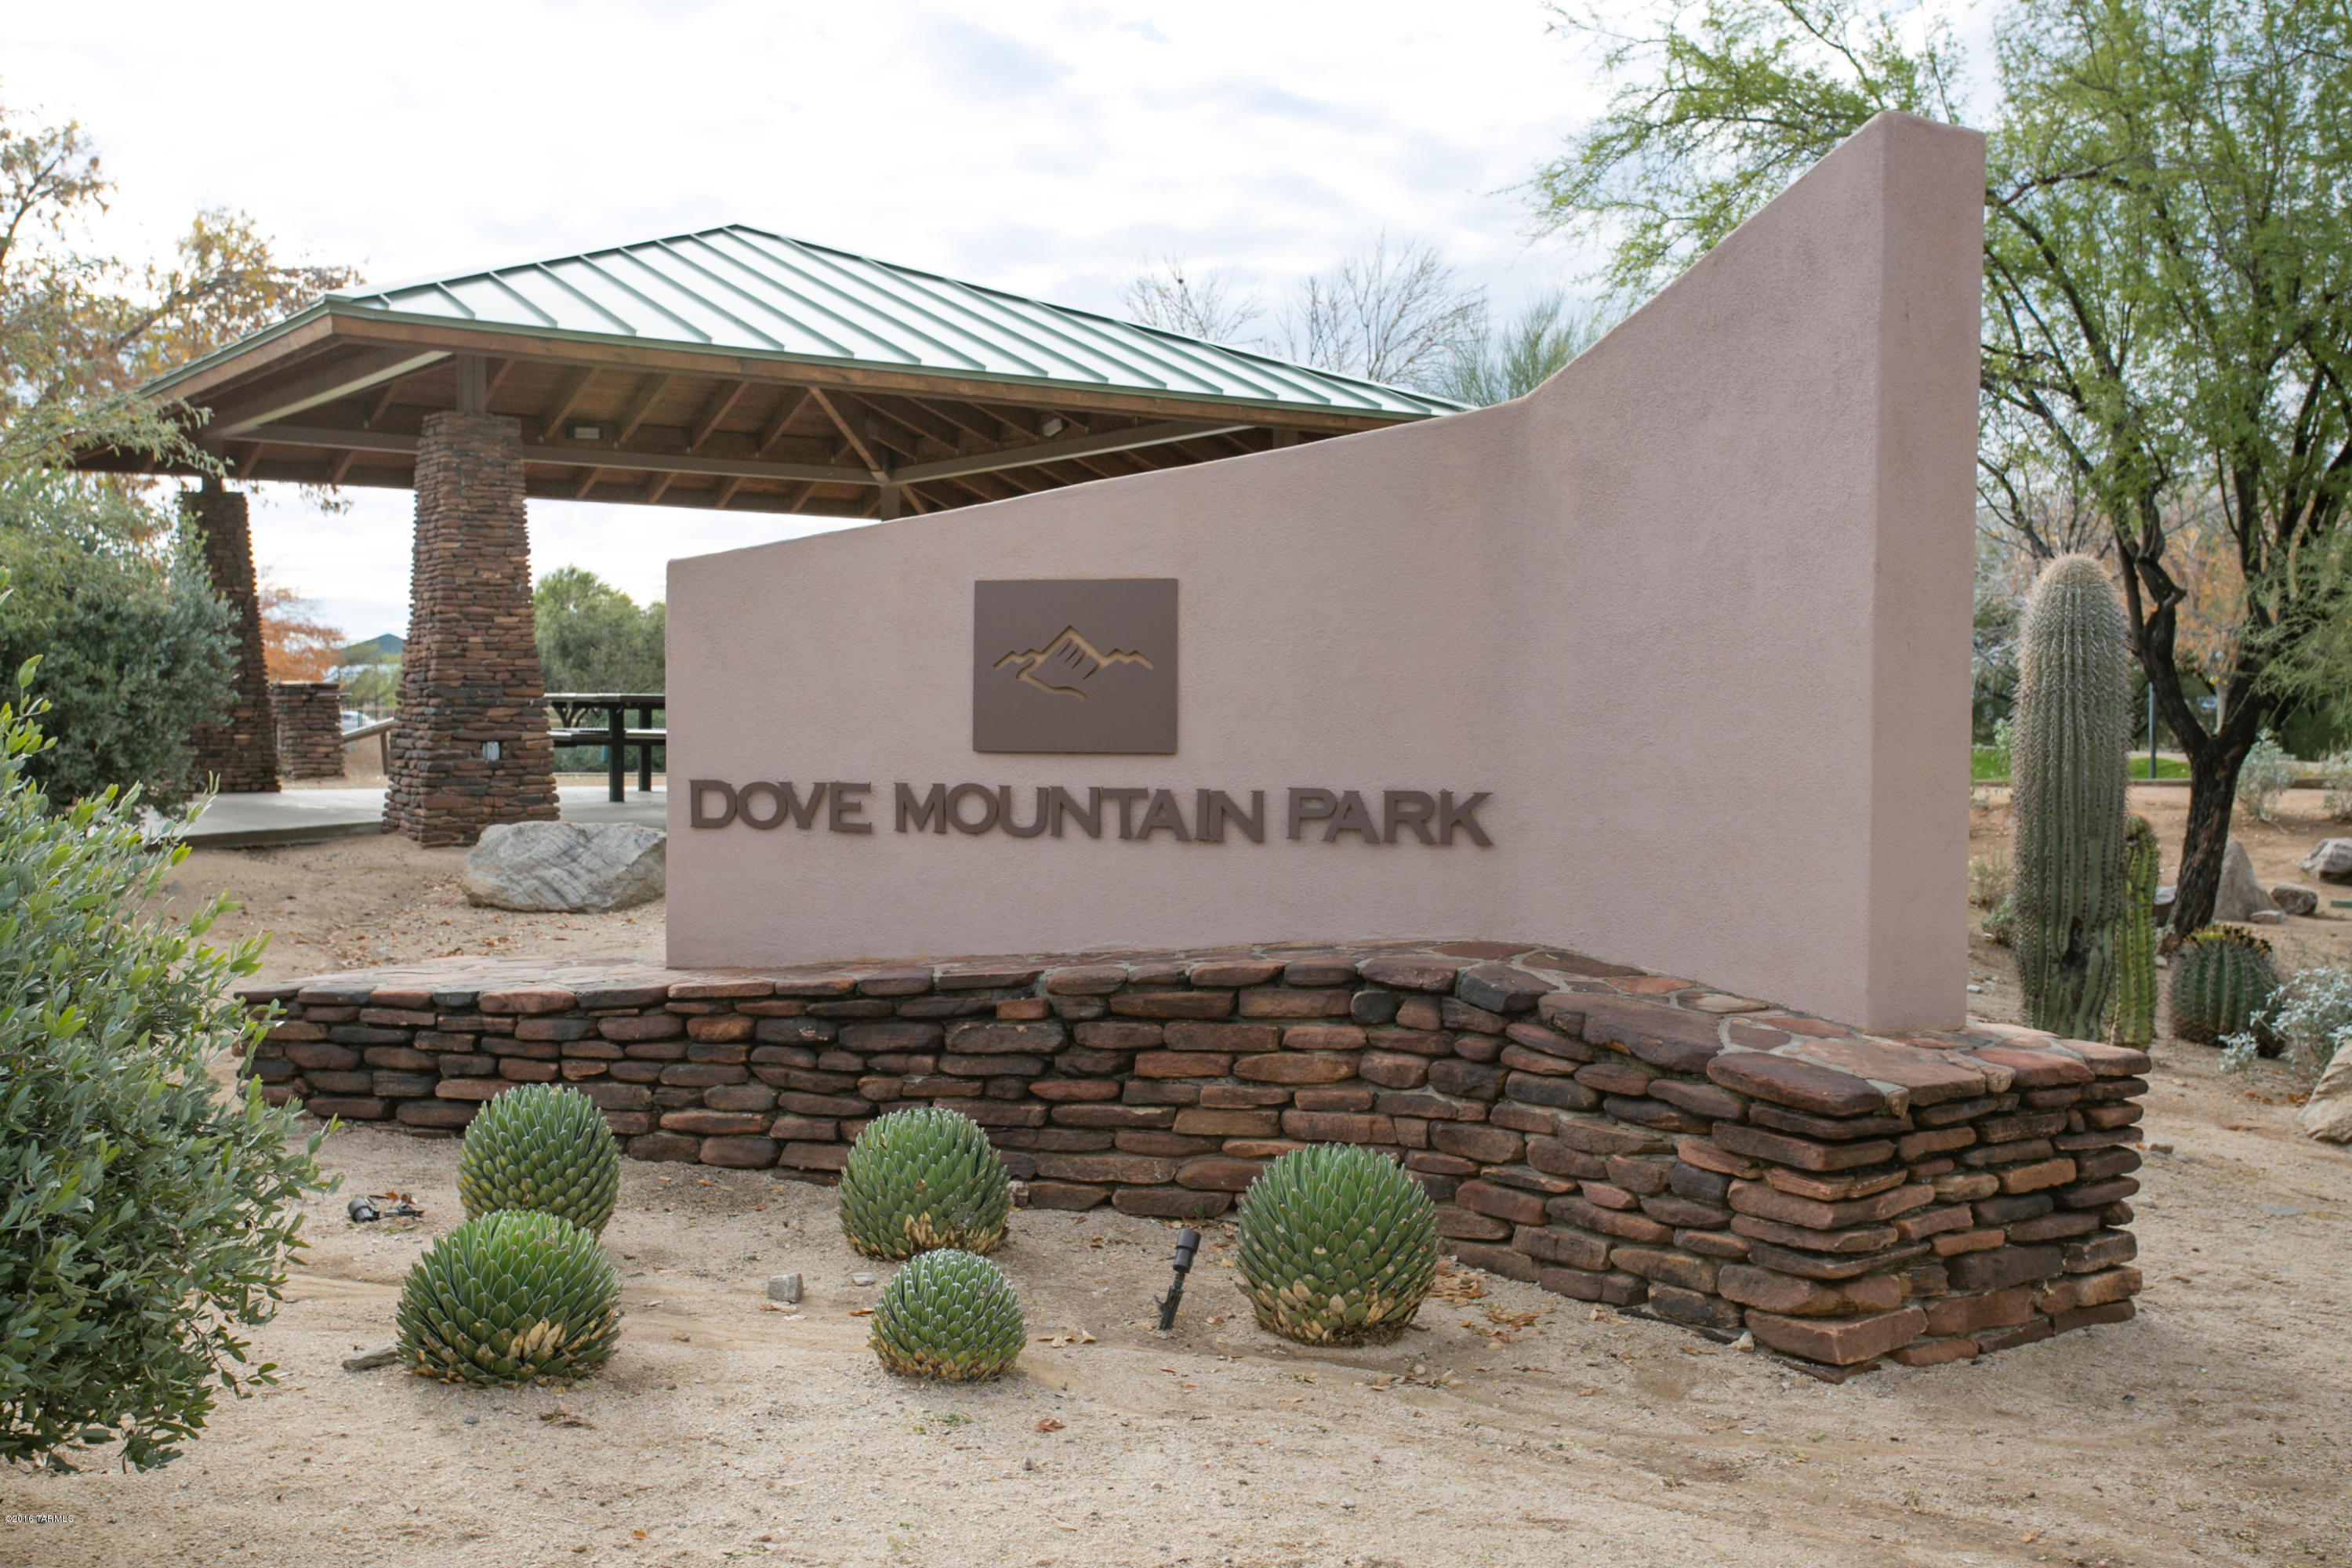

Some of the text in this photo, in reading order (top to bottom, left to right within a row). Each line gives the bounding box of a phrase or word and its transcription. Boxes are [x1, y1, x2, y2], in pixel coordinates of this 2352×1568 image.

[689, 779, 1494, 846] DOVE MOUNTAIN PARK
